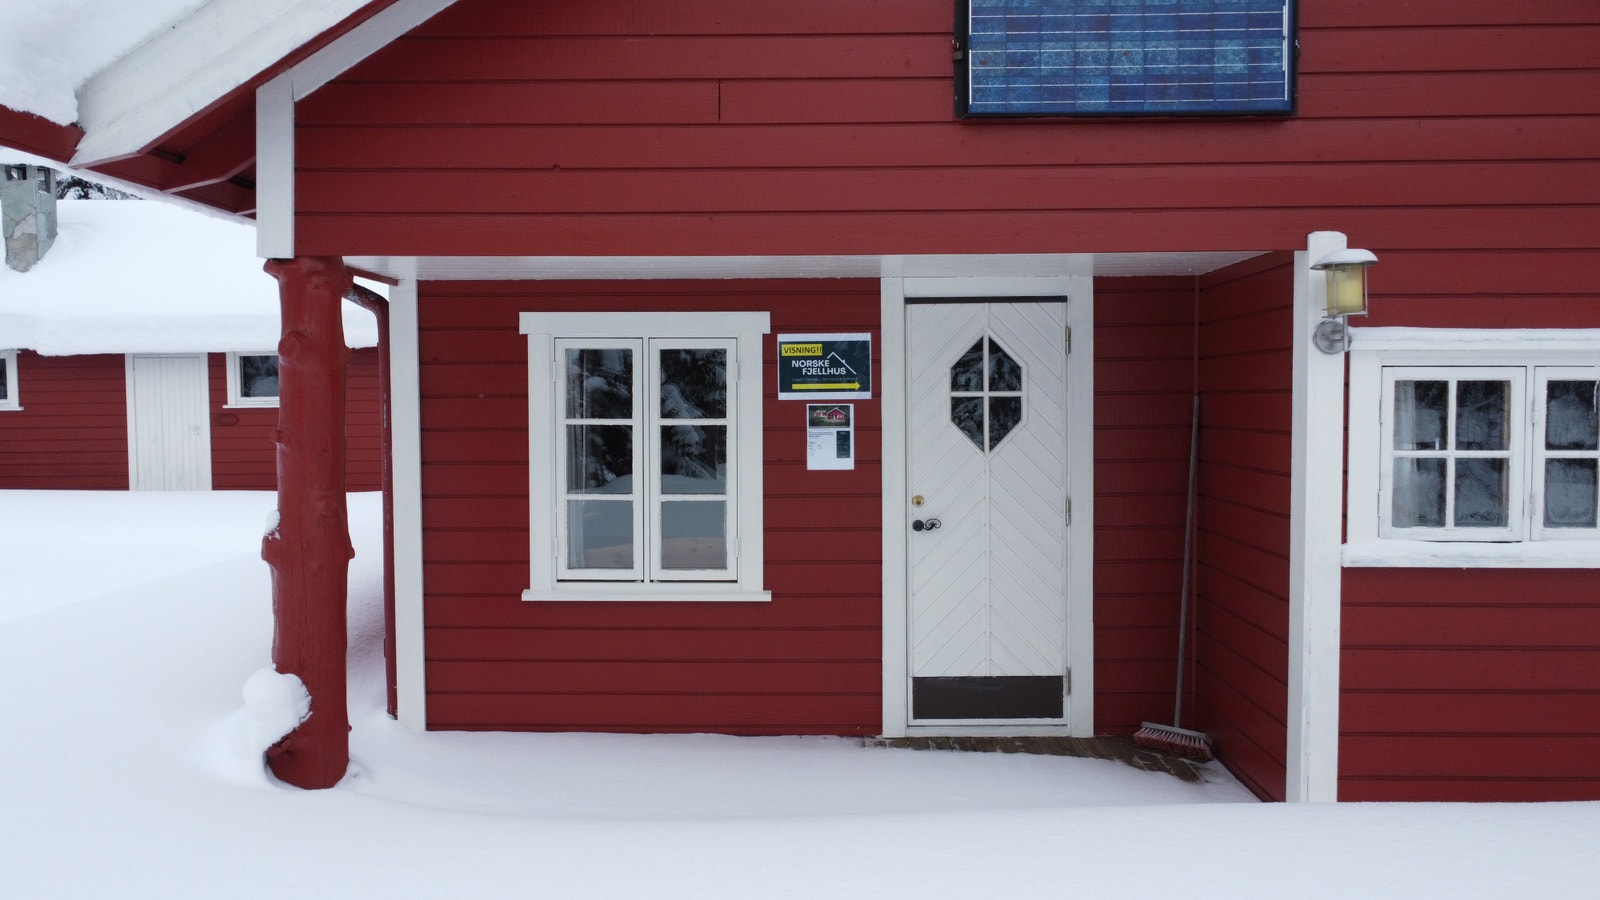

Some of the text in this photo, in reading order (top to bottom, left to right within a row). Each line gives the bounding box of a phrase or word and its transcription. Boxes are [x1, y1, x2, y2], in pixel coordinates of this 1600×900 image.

[783, 346, 822, 354] VISNING!!
[791, 360, 830, 368] NORSKE
[802, 367, 847, 375] FJELLHUS
